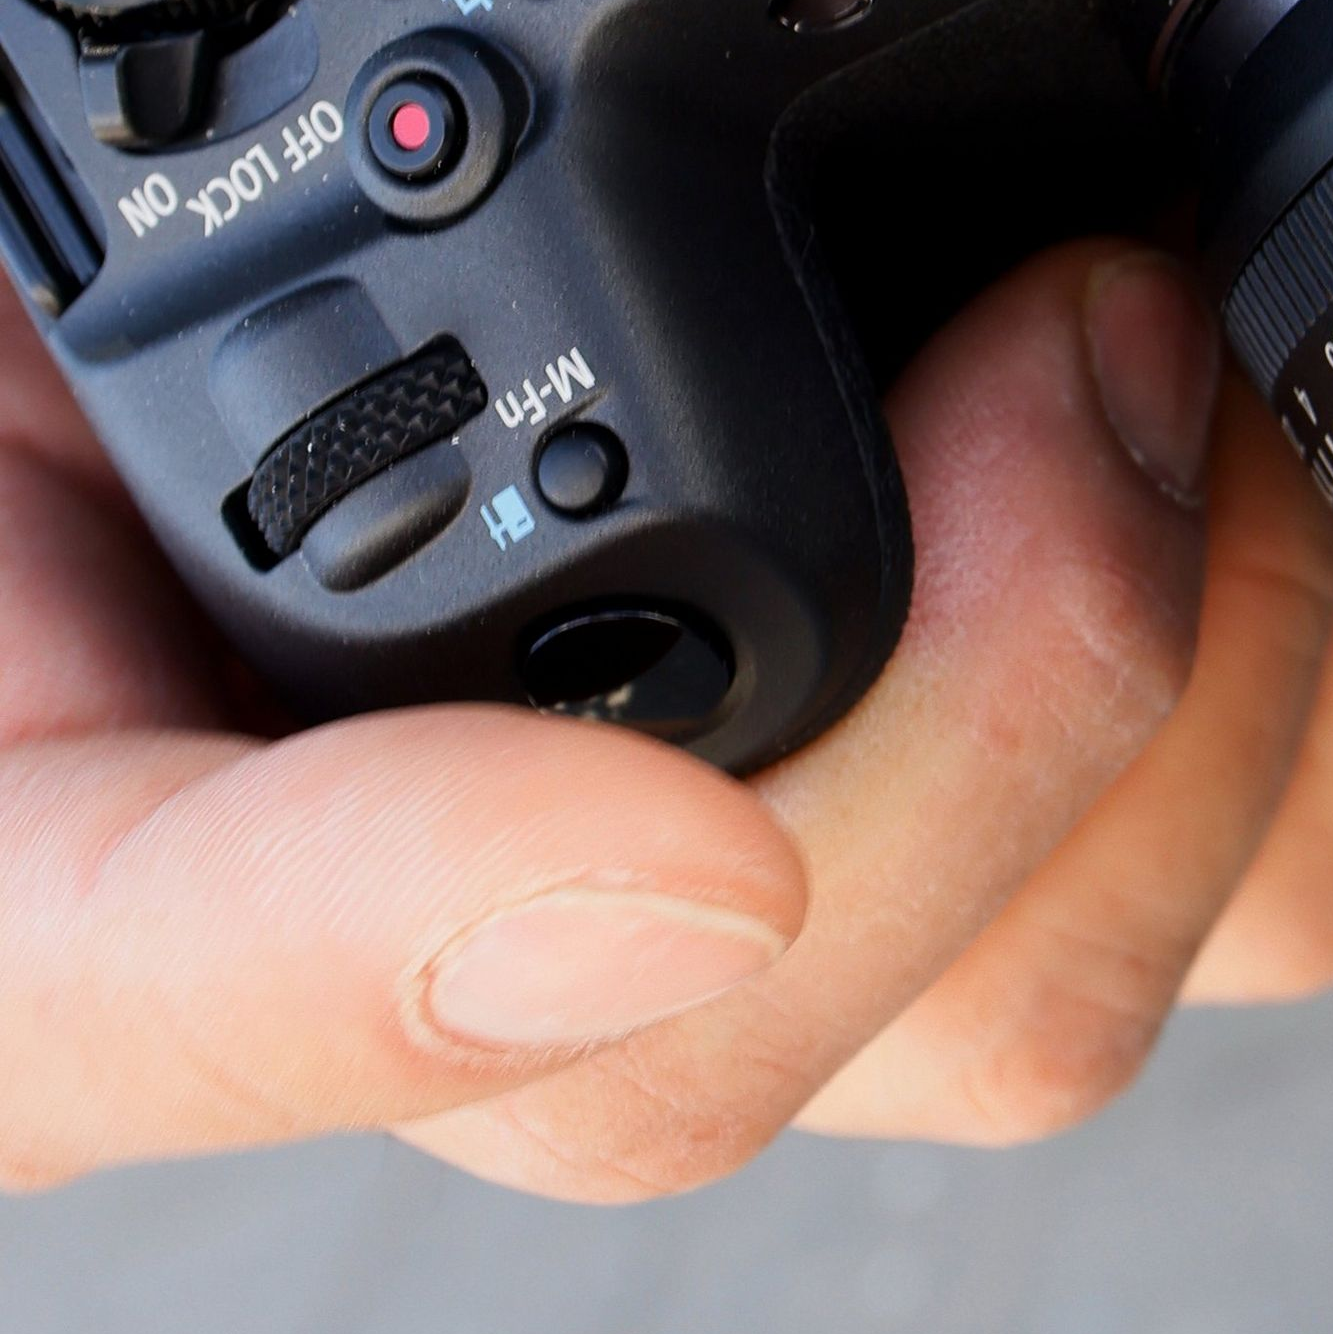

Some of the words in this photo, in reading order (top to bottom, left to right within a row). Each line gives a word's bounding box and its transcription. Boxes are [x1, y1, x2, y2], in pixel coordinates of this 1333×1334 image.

[282, 99, 344, 173] OFF
[118, 171, 178, 237] ON
[186, 150, 280, 236] LOCK
[495, 347, 596, 428] M-Fn
